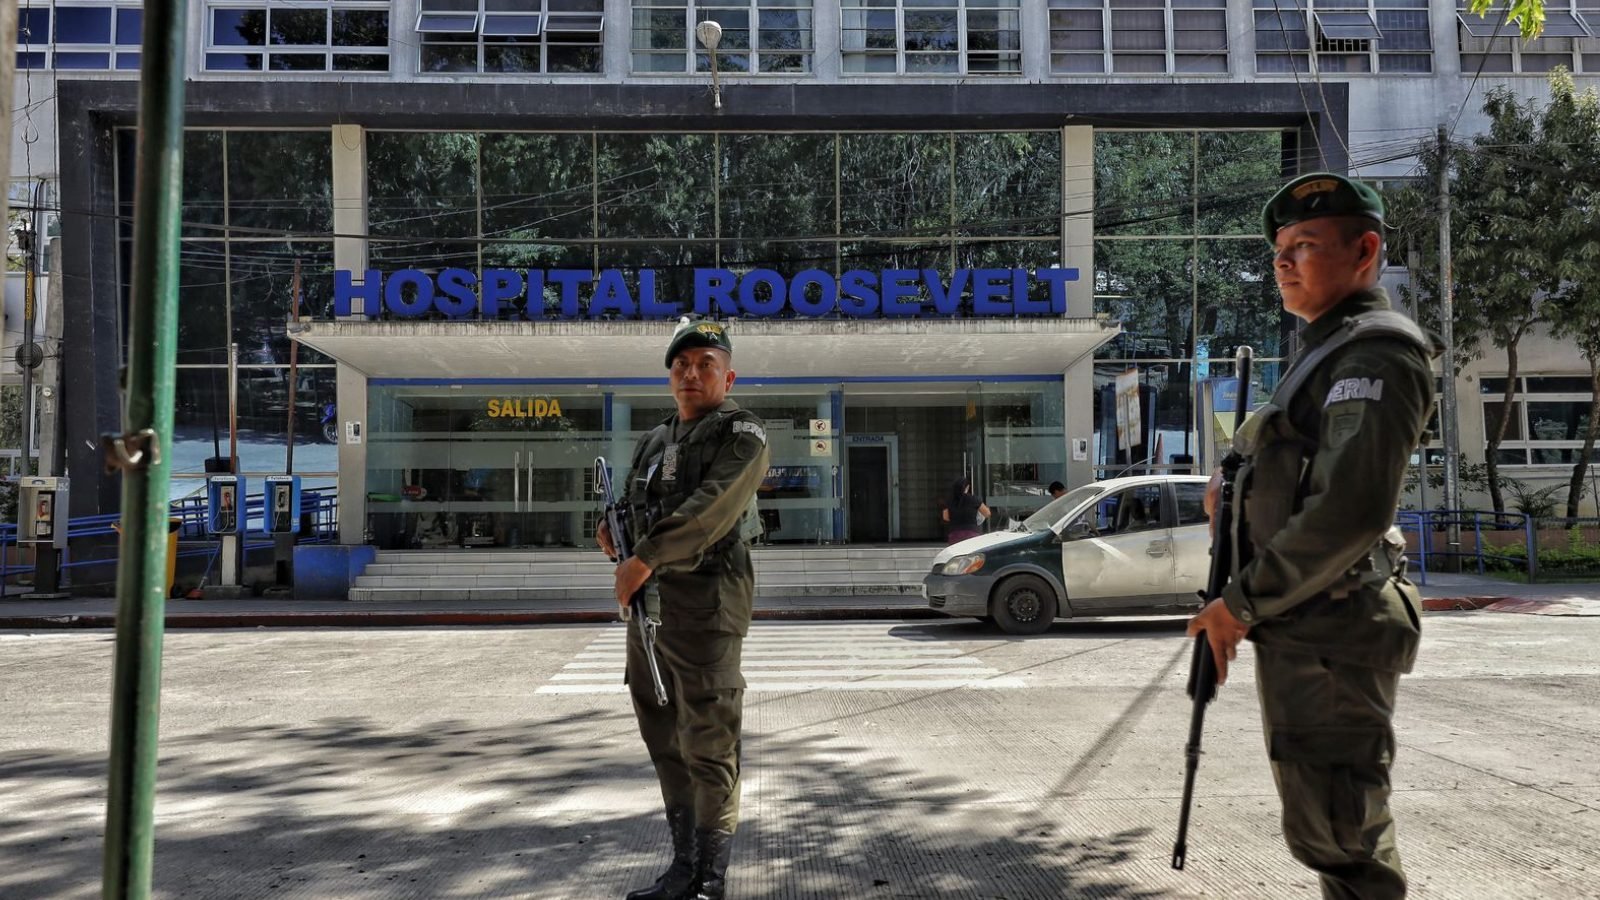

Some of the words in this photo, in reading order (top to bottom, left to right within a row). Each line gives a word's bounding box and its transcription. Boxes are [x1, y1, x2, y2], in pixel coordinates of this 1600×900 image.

[334, 268, 677, 317] HOSPITAL
[694, 268, 1079, 315] ROOSEVELT
[487, 399, 562, 417] SALIDA
